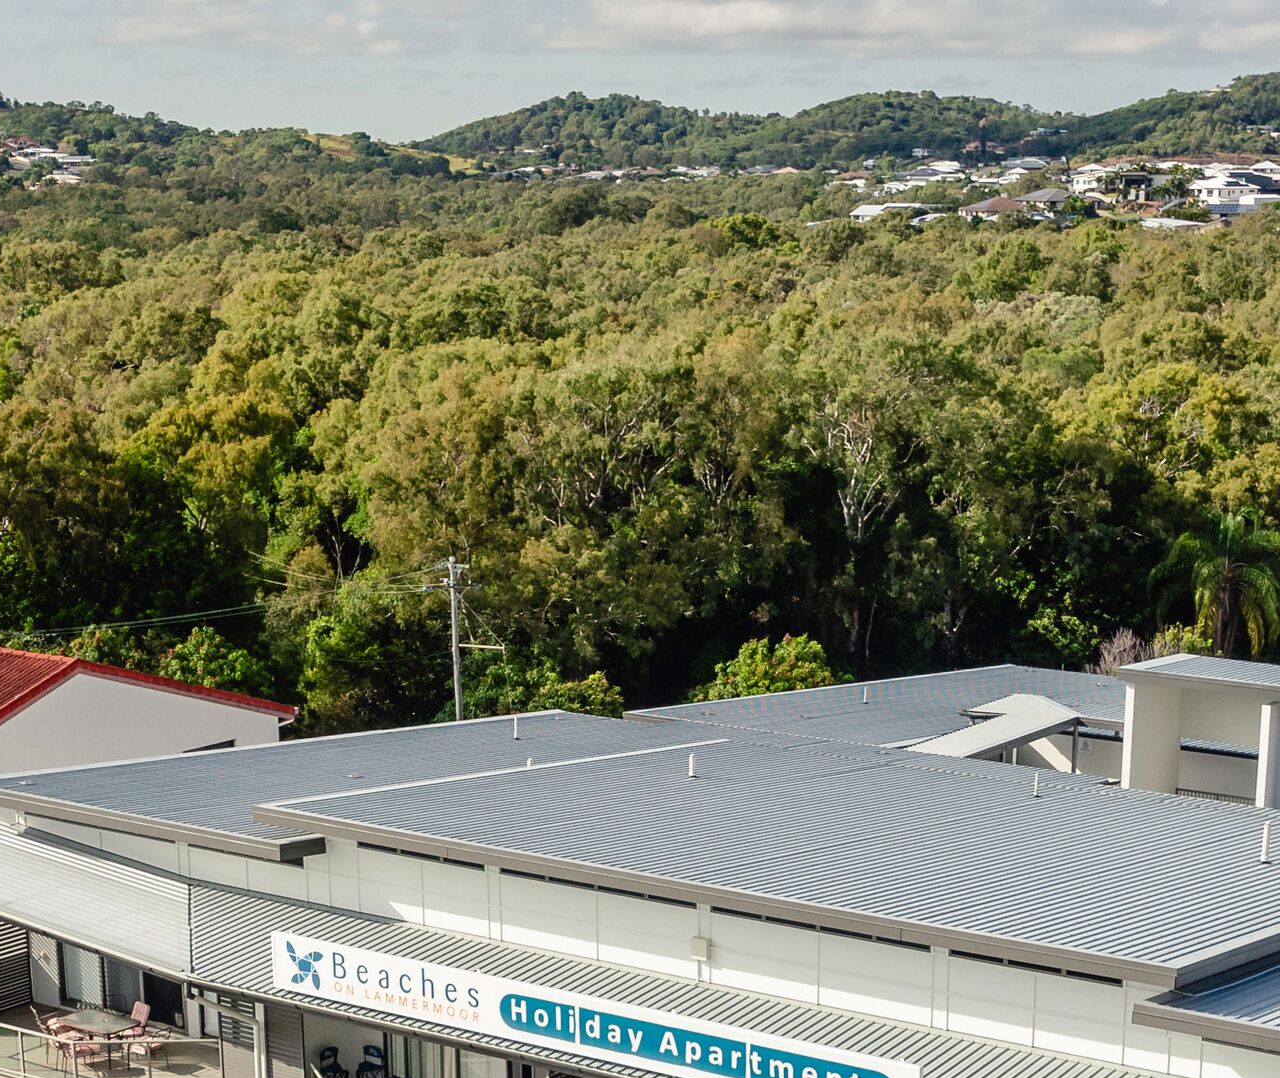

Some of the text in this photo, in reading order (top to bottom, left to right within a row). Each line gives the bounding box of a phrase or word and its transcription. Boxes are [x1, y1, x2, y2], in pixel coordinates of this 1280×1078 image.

[332, 952, 479, 1008] Beaches
[333, 981, 480, 1022] ON LAMMERMOOR
[510, 998, 643, 1053] Holiday
